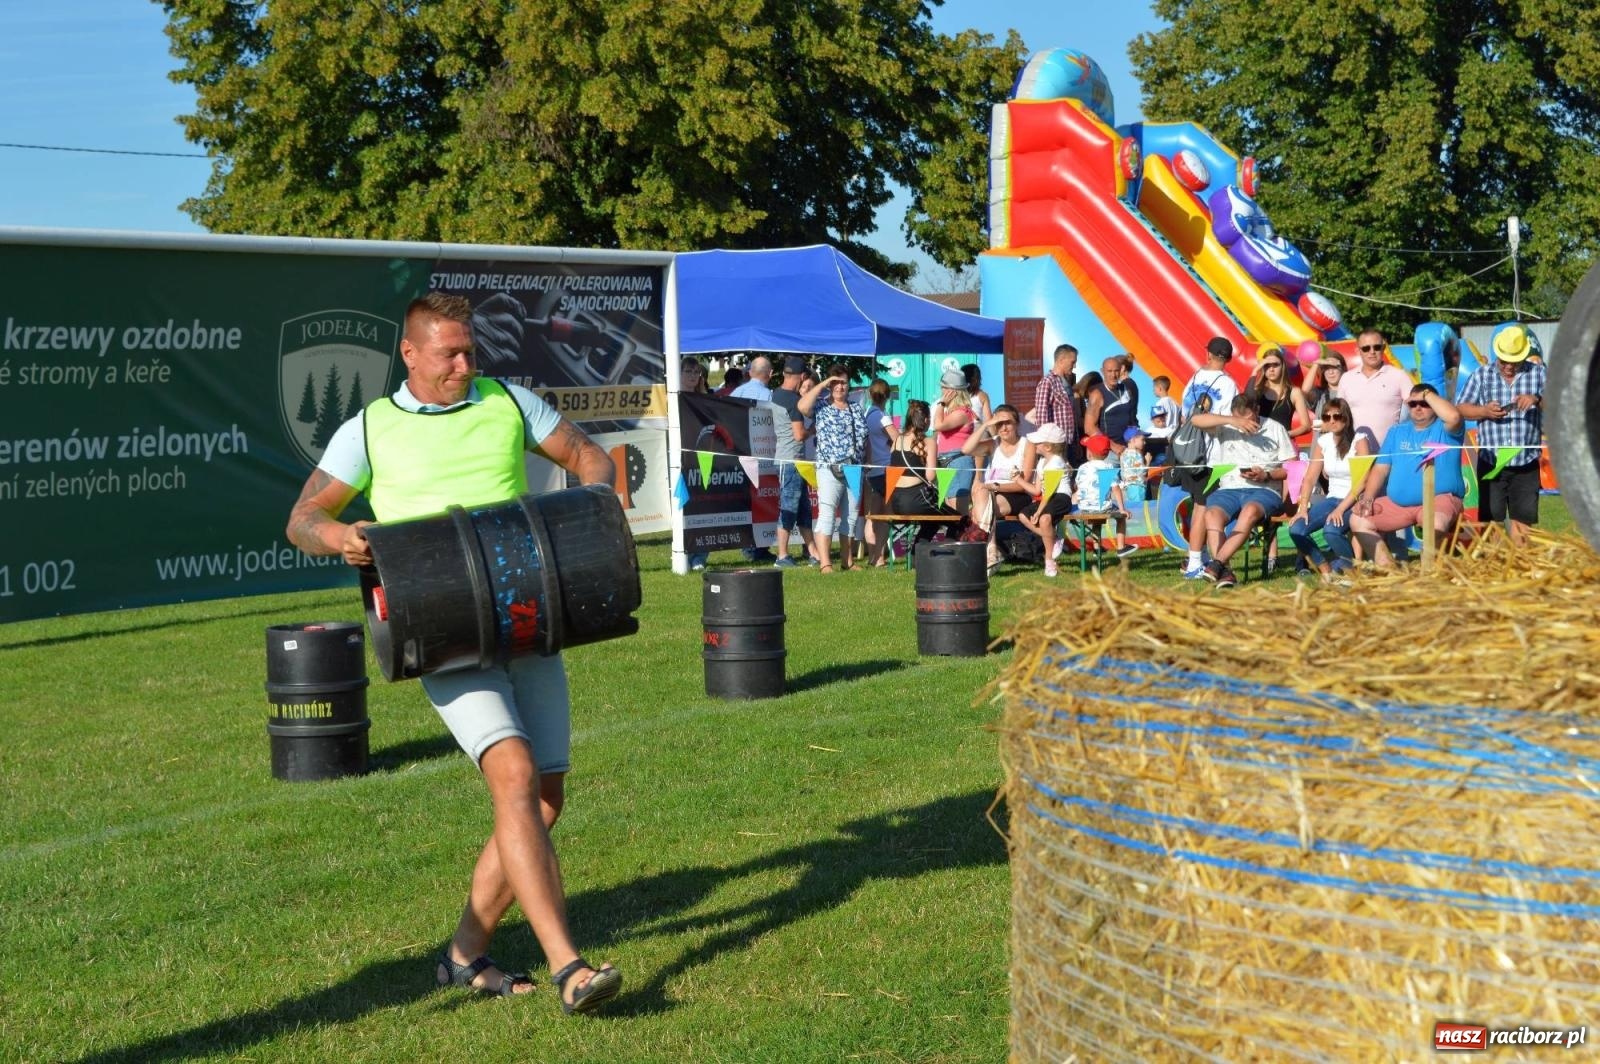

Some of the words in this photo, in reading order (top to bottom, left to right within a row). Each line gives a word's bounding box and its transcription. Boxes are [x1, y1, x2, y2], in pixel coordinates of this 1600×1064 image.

[429, 272, 476, 290] STUDIO
[477, 273, 555, 294] PIELĘGNACJI
[562, 275, 653, 291] POLEROWANIA
[559, 293, 652, 311] SAMOCHODÓW
[4, 317, 115, 357] krzewy
[122, 319, 243, 351] ozdobne
[301, 319, 378, 344] JODEŁKA
[18, 363, 99, 390] stromy
[105, 366, 117, 383] a
[124, 358, 172, 384] keře
[561, 392, 589, 411] 503
[593, 391, 616, 410] 573
[620, 389, 652, 408] 845
[117, 423, 249, 462] zielonych
[25, 469, 121, 499] zelených
[128, 465, 187, 498] ploch
[23, 558, 77, 595] 002
[282, 700, 333, 719] RACIBÓRZ
